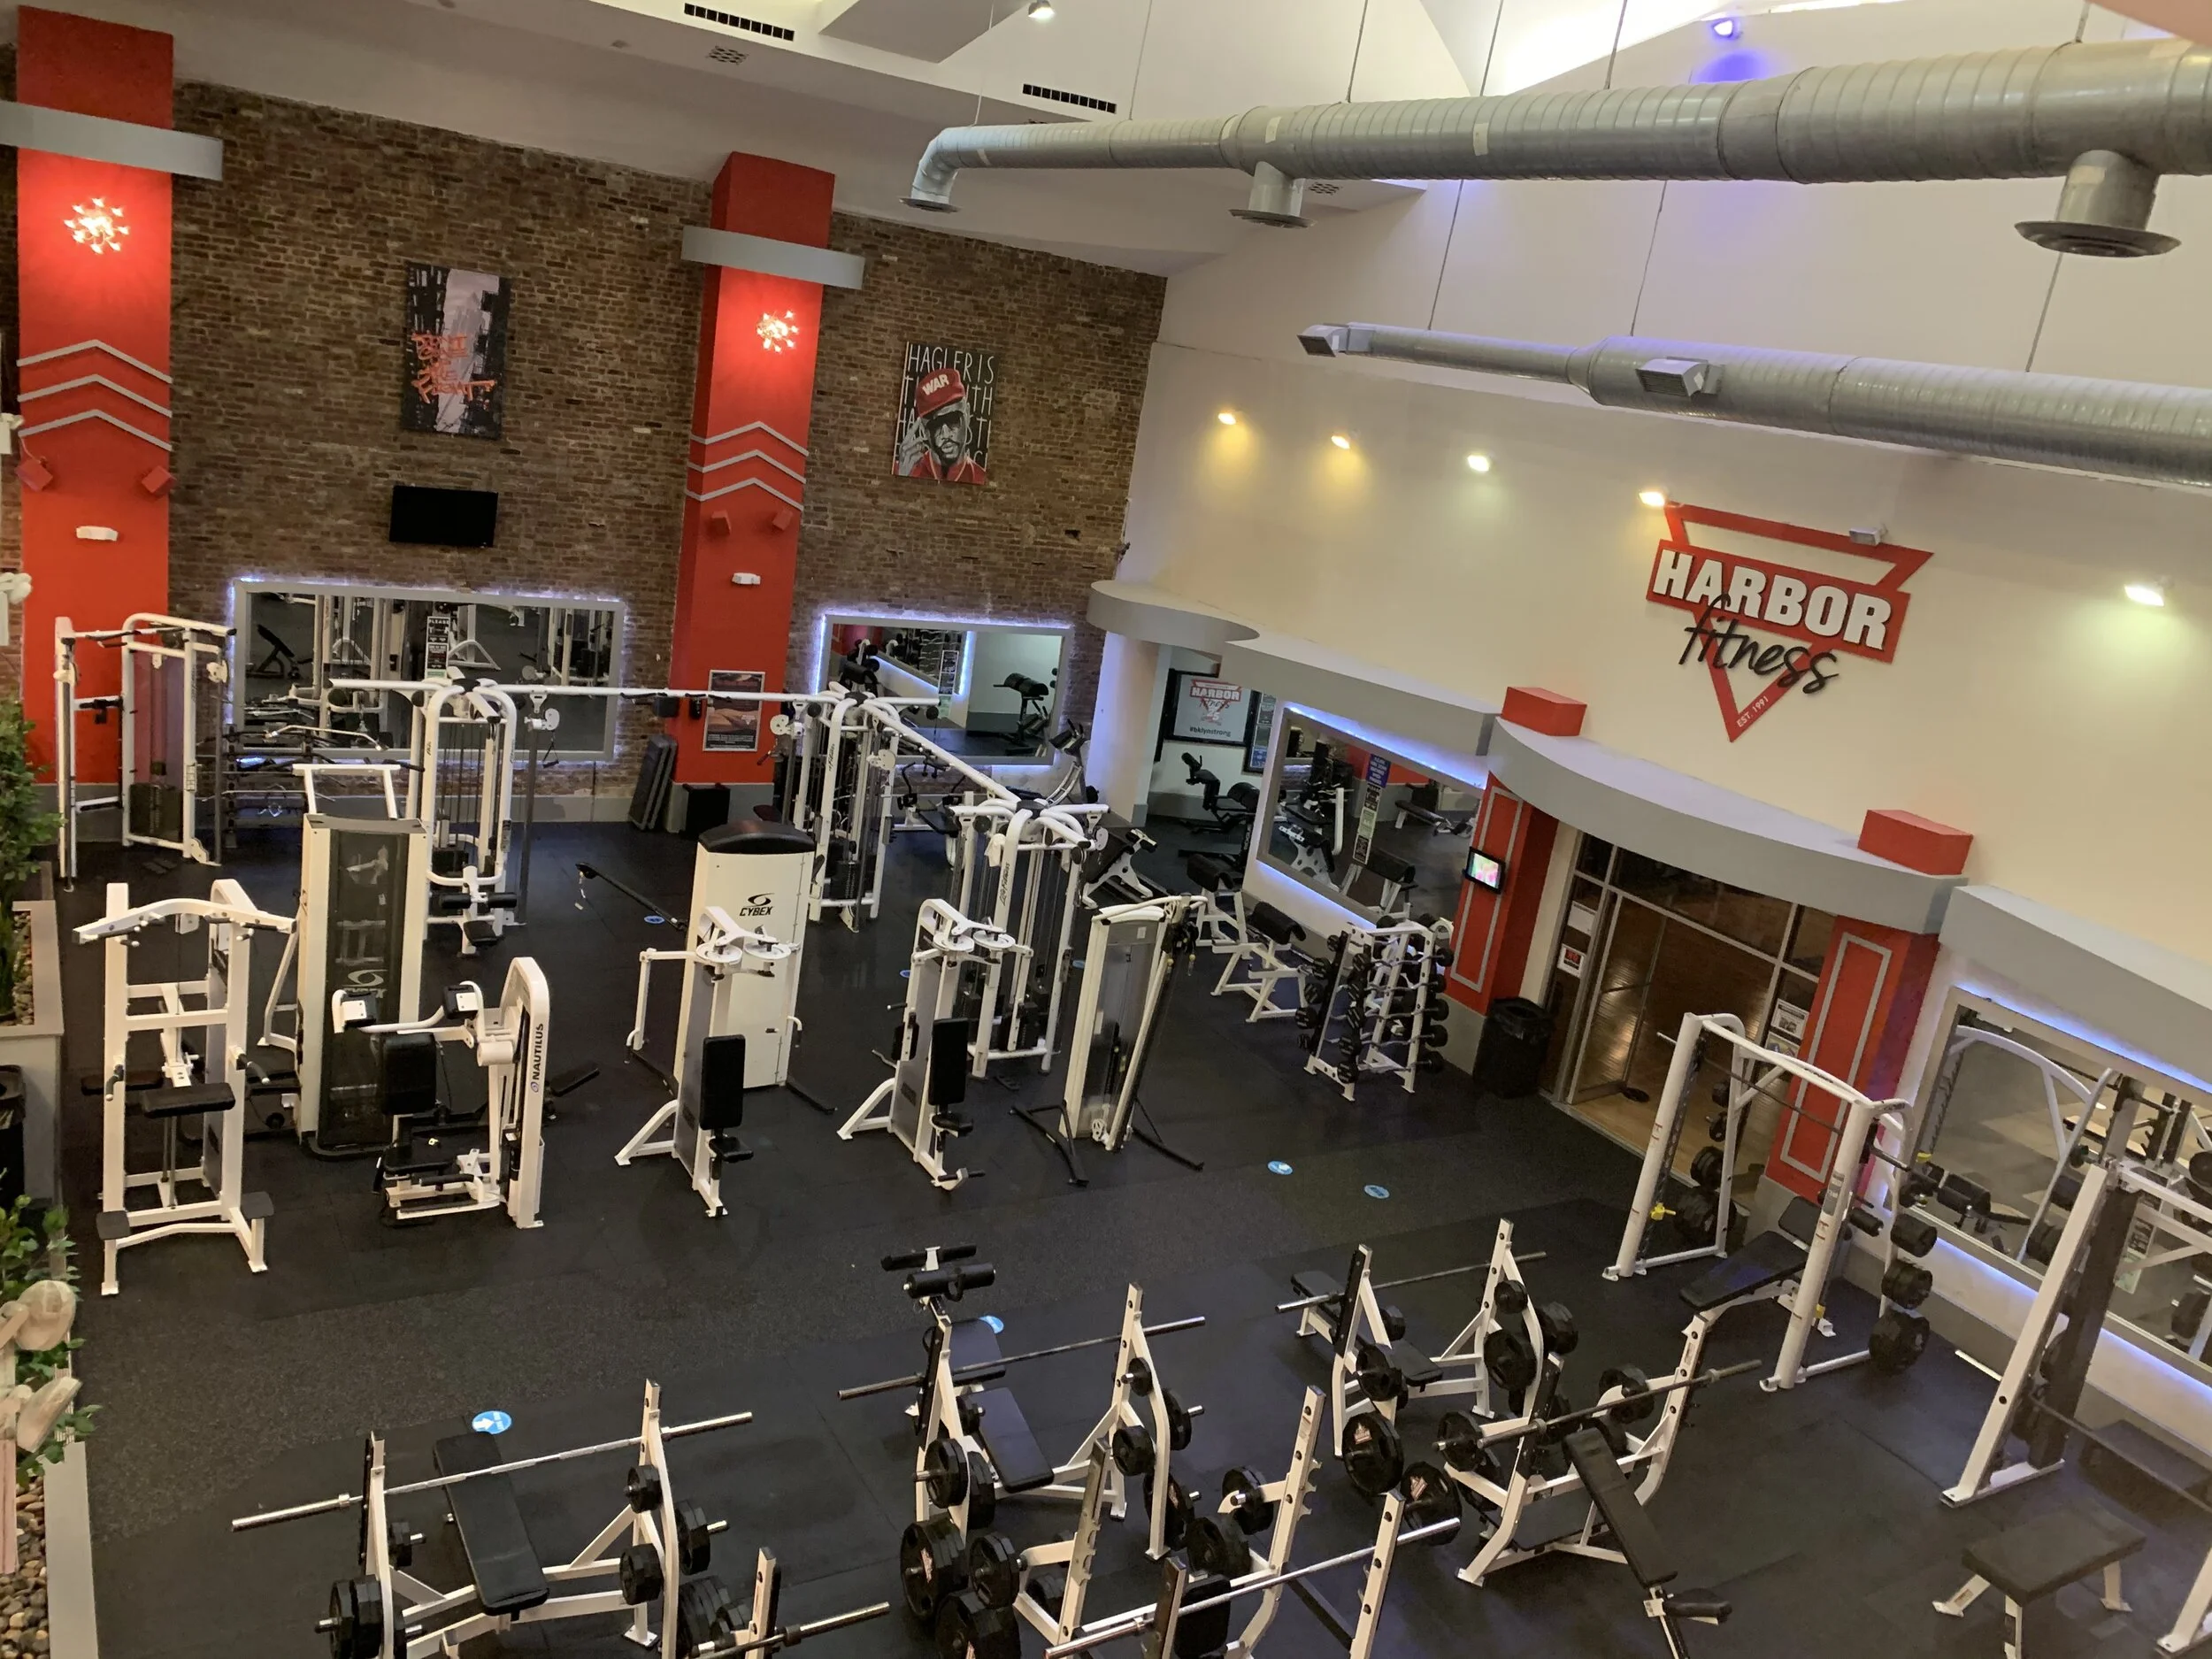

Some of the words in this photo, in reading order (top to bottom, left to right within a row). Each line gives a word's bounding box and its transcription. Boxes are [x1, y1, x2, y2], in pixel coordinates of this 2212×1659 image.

[922, 374, 949, 396] WAR
[977, 354, 995, 385] IS
[1653, 549, 1892, 650] HARBOR
[1678, 593, 1839, 694] fitness
[1191, 687, 1240, 701] HARBOR
[1736, 710, 1754, 727] EST.
[1753, 695, 1769, 712] 1991
[1189, 726, 1232, 737] #bklynstrong
[740, 906, 773, 917] CYBEX
[532, 1023, 544, 1080] NAUTILUS
